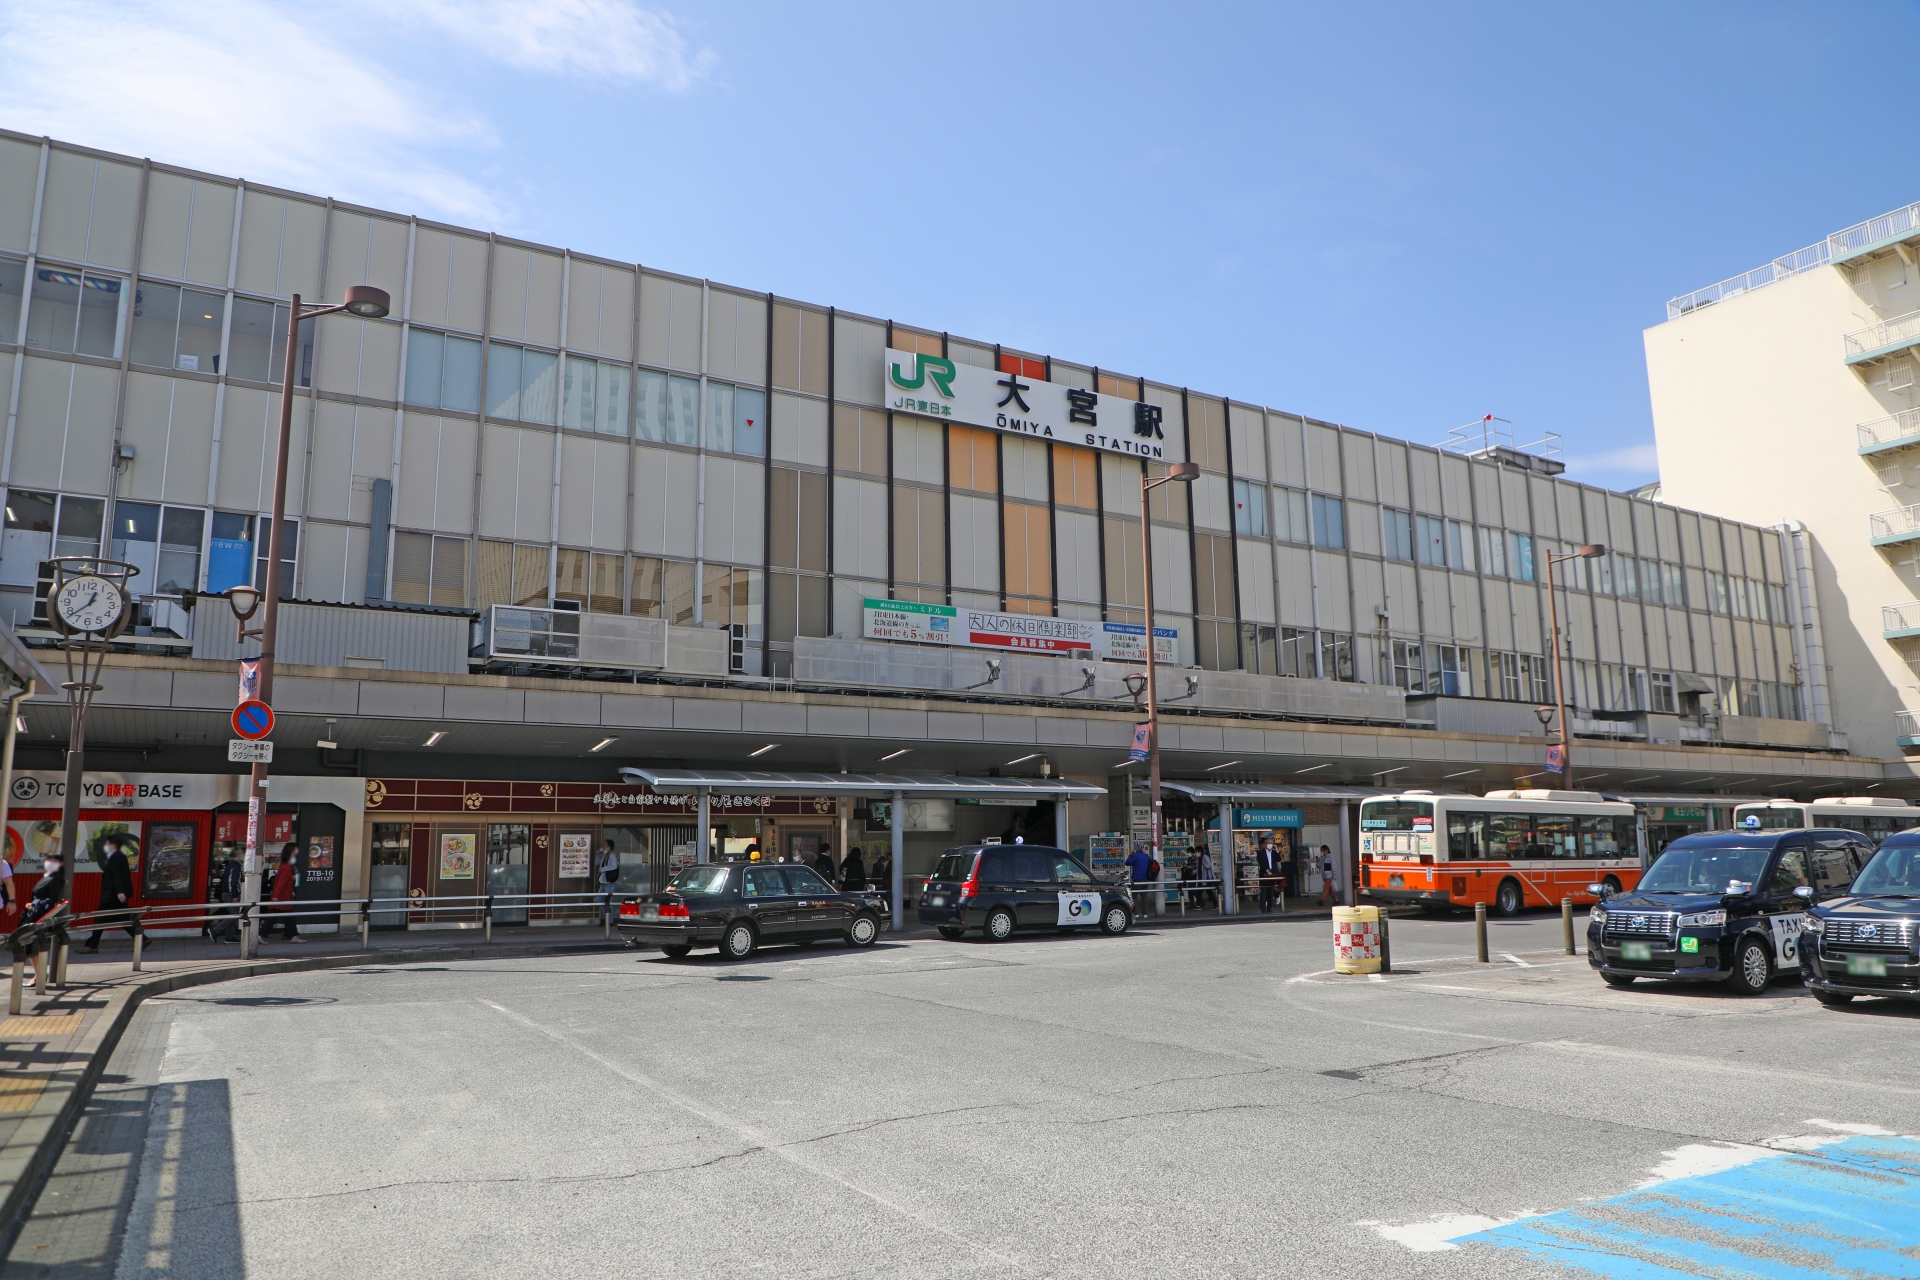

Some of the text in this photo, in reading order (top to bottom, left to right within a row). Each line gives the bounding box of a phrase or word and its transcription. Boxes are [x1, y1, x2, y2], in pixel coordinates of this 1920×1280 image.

[890, 353, 957, 399] JR
[894, 397, 952, 417] JR東日本
[997, 374, 1164, 440] 大宮駅
[1085, 433, 1163, 458] STATION
[77, 583, 85, 591] 11
[87, 582, 97, 590] 12
[102, 585, 105, 593] 1
[67, 589, 77, 597] 10
[107, 592, 114, 600] 2
[64, 598, 71, 606] 9
[108, 602, 116, 610] 3
[66, 607, 74, 615] 8
[104, 610, 111, 618] 4
[920, 606, 942, 614] ミドル
[84, 618, 91, 626] 6
[95, 616, 102, 624] 5
[968, 612, 1079, 639] 大人の休日倶楽部
[1010, 637, 1055, 649] 会員募集中
[232, 743, 270, 751] タクシー乗場の
[232, 752, 269, 760] タクシーを除く
[1069, 900, 1092, 916] GO
